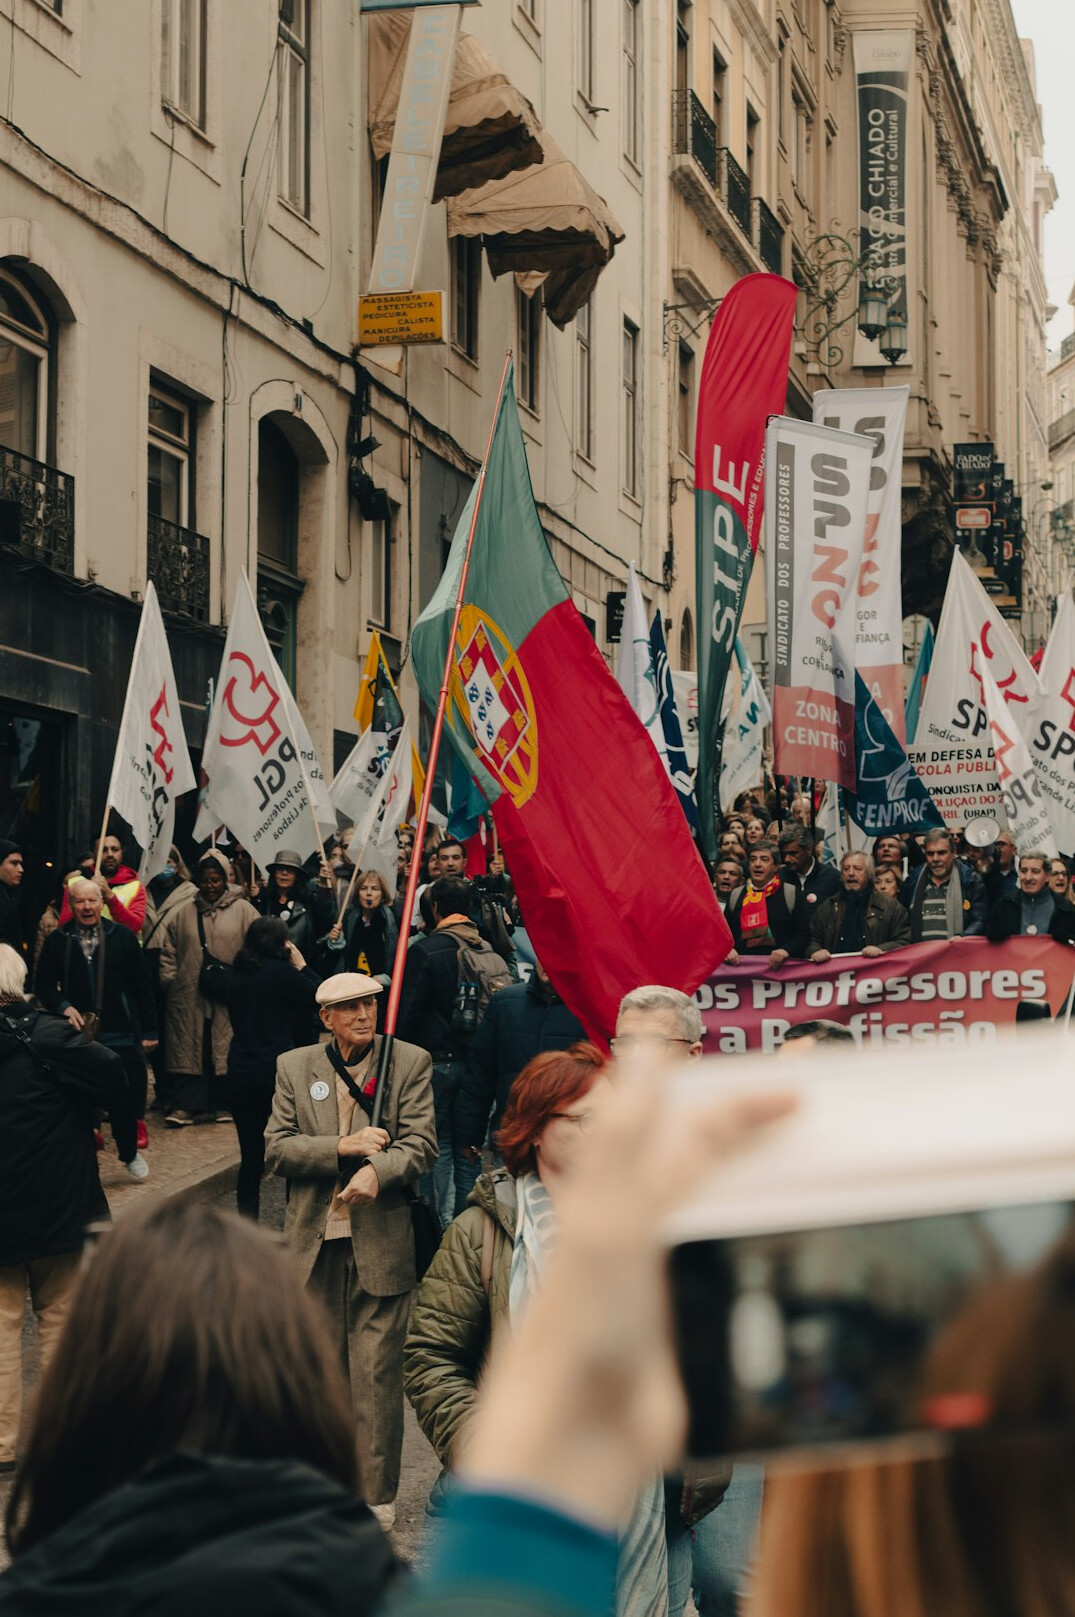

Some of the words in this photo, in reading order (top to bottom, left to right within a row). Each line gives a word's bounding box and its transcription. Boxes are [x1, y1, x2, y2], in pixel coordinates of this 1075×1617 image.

[886, 109, 898, 161] Cultural
[378, 14, 448, 288] CABELEIREIRO
[868, 108, 885, 197] CHIADO
[889, 164, 898, 172] e
[886, 176, 898, 239] Cmercial
[363, 294, 422, 304] MASSAGISTA
[377, 302, 434, 311] ESTETICISTA
[363, 311, 408, 319] PEDICURA
[397, 317, 435, 325] CALISTA
[363, 326, 411, 335] MANICURA
[778, 463, 790, 550] PROFESSORES
[711, 444, 750, 653] SIPE
[778, 562, 790, 587] DOS
[857, 611, 877, 620] GOR
[776, 599, 790, 666] SINDICATO
[860, 622, 865, 632] E
[856, 633, 890, 645] FIANÇA
[795, 700, 841, 728] ZONA
[952, 699, 987, 737] SP
[784, 726, 847, 757] CENTRO
[908, 752, 926, 763] EM
[931, 748, 982, 761] DEFESA
[916, 764, 952, 776] COLA
[927, 784, 983, 796] ONQUISTA
[980, 795, 996, 804] DO
[857, 798, 930, 829] FENPROF
[942, 809, 958, 819] RIL
[963, 808, 996, 820] (URAP)
[696, 981, 740, 1010] os
[751, 968, 1047, 1010] Professores
[719, 1025, 747, 1053] a
[761, 1009, 997, 1054] Pfissão
